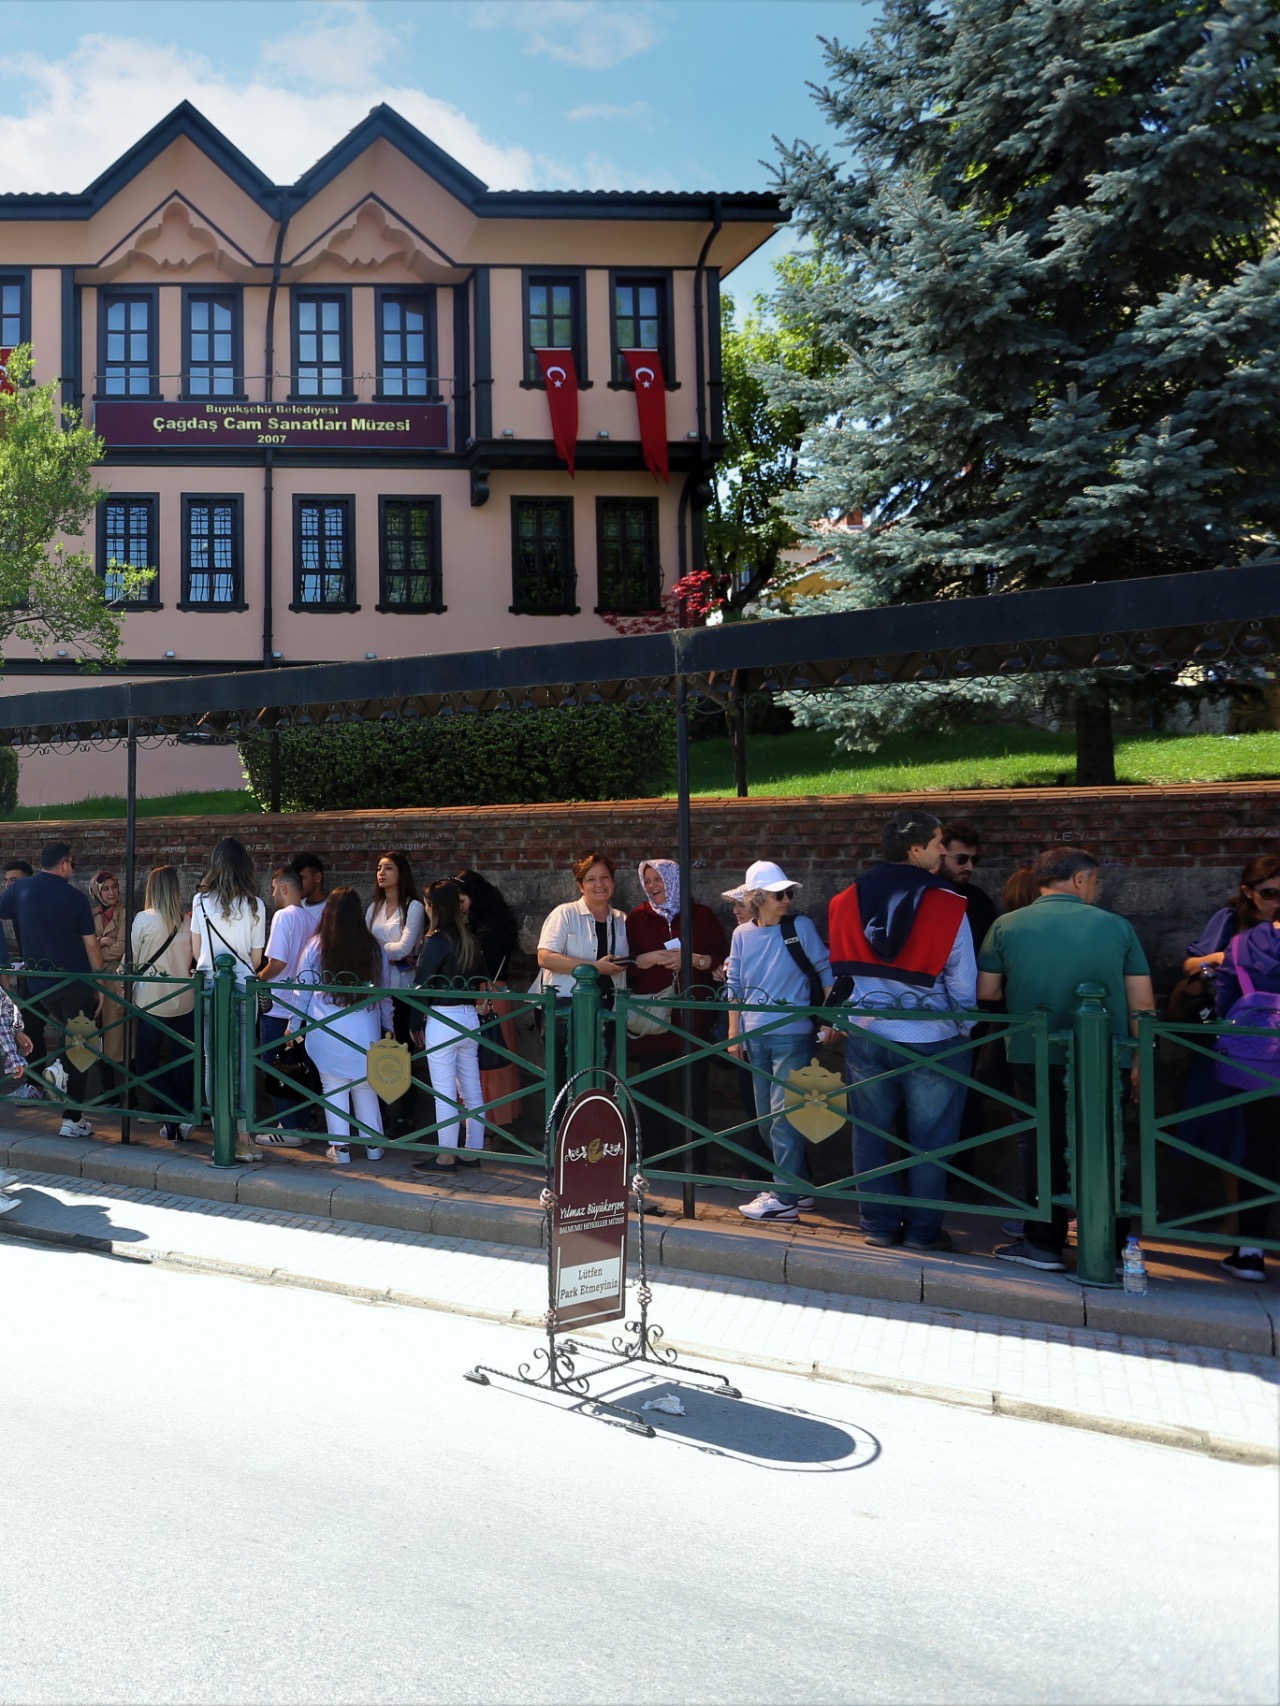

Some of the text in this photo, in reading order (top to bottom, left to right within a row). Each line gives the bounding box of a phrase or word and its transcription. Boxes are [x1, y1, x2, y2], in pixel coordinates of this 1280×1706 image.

[276, 405, 339, 416] Belediyesi
[153, 416, 410, 433] Çağdaş Cam Sanatları Müzesi
[257, 434, 287, 443] 2007
[560, 1199, 625, 1220] Yılmaz Büyükerşen
[578, 1266, 603, 1280] Lütfen
[560, 1279, 618, 1299] Park Etmeyiniz
